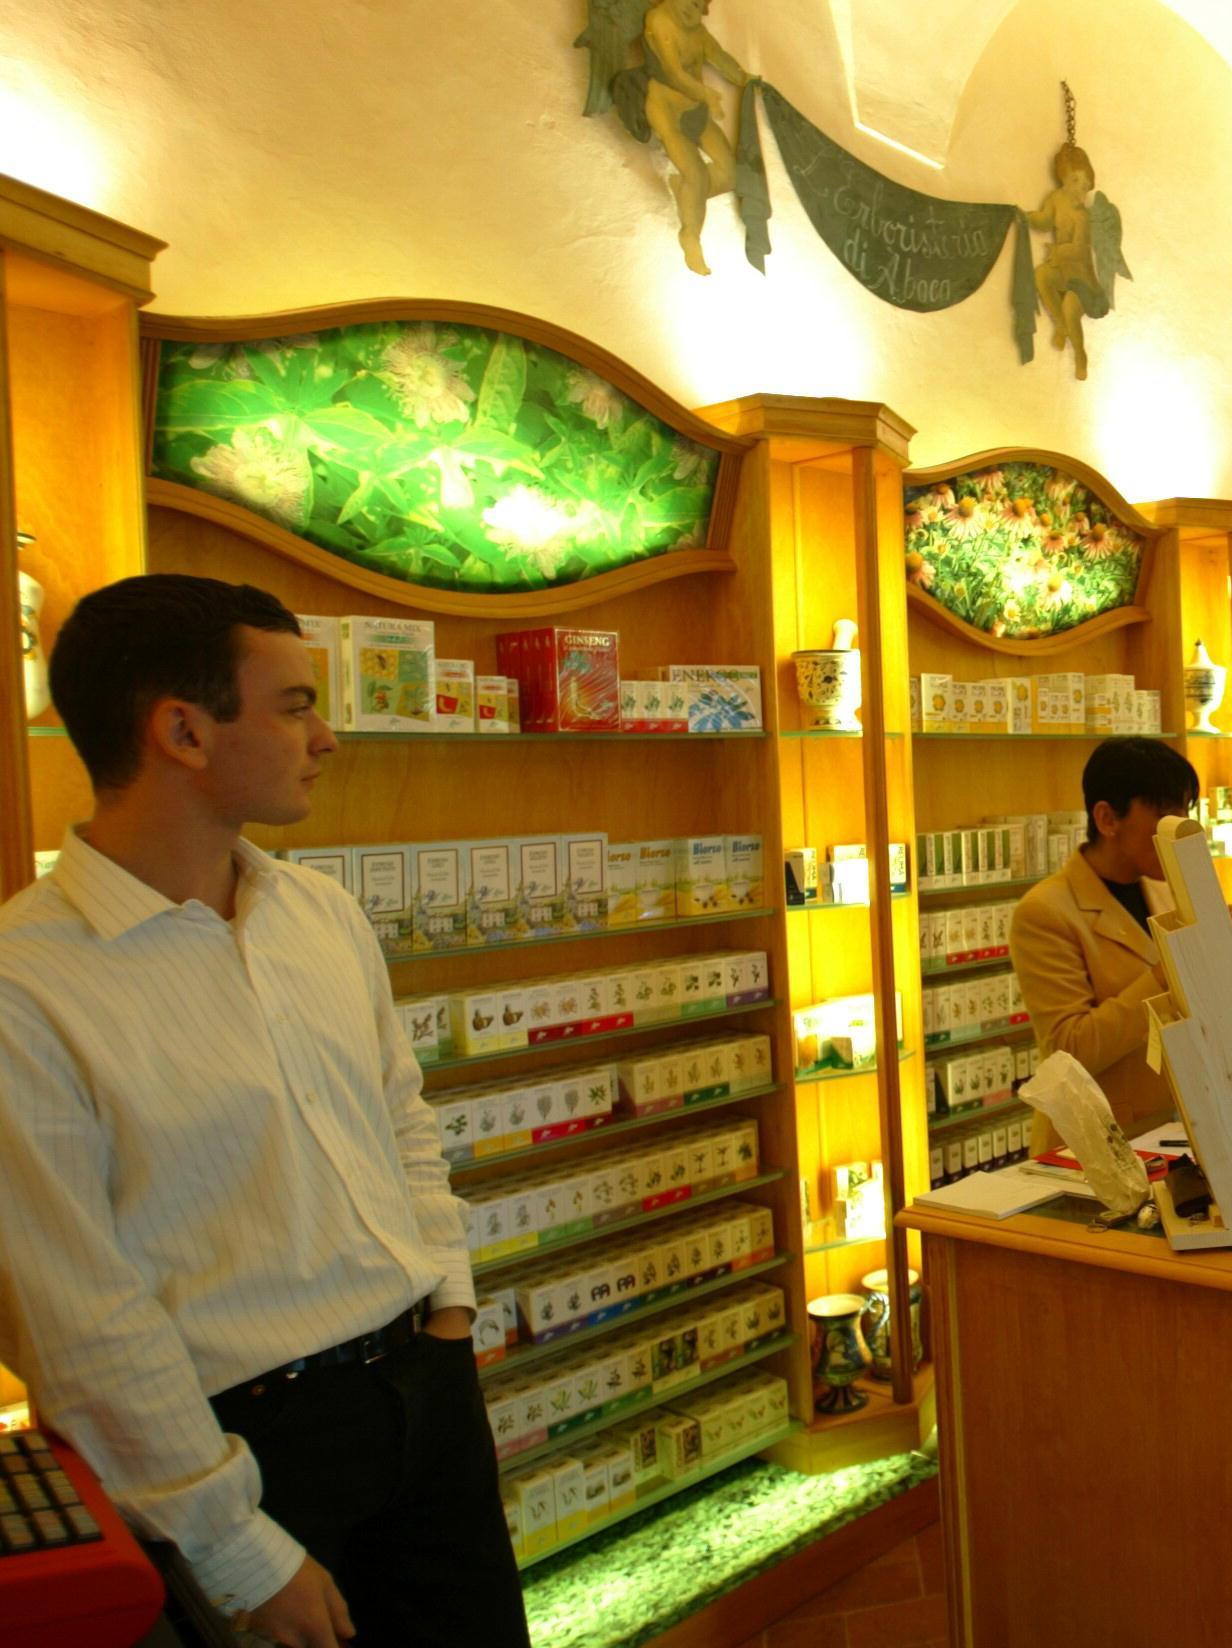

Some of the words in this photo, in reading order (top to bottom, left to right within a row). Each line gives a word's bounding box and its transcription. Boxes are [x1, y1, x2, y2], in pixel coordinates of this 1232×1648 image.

[844, 229, 870, 279] di
[867, 247, 951, 303] Aboca
[564, 635, 610, 647] GINSENG
